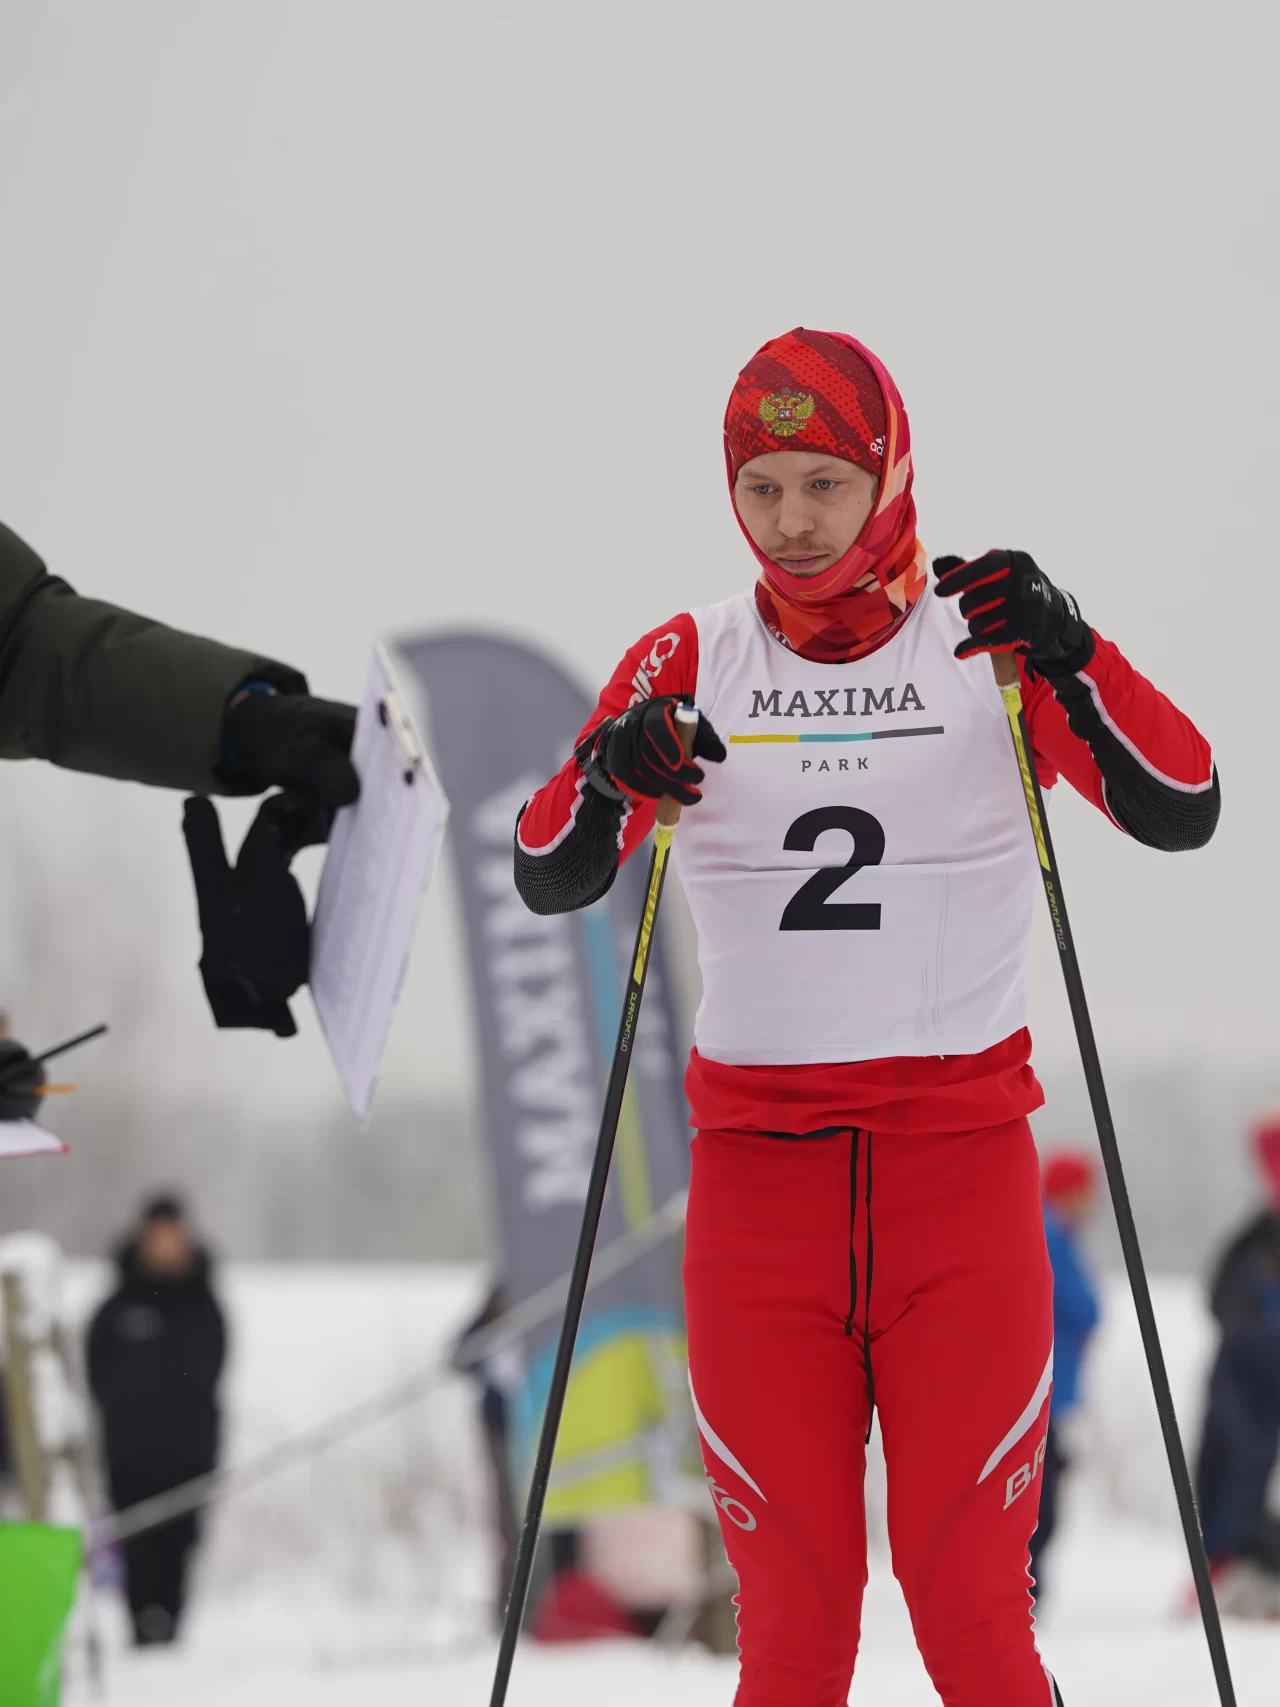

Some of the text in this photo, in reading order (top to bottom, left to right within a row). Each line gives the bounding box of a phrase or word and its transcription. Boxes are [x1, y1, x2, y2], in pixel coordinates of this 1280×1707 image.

[748, 683, 925, 718] MAXIMA
[801, 757, 869, 772] PARK
[778, 805, 886, 931] 2
